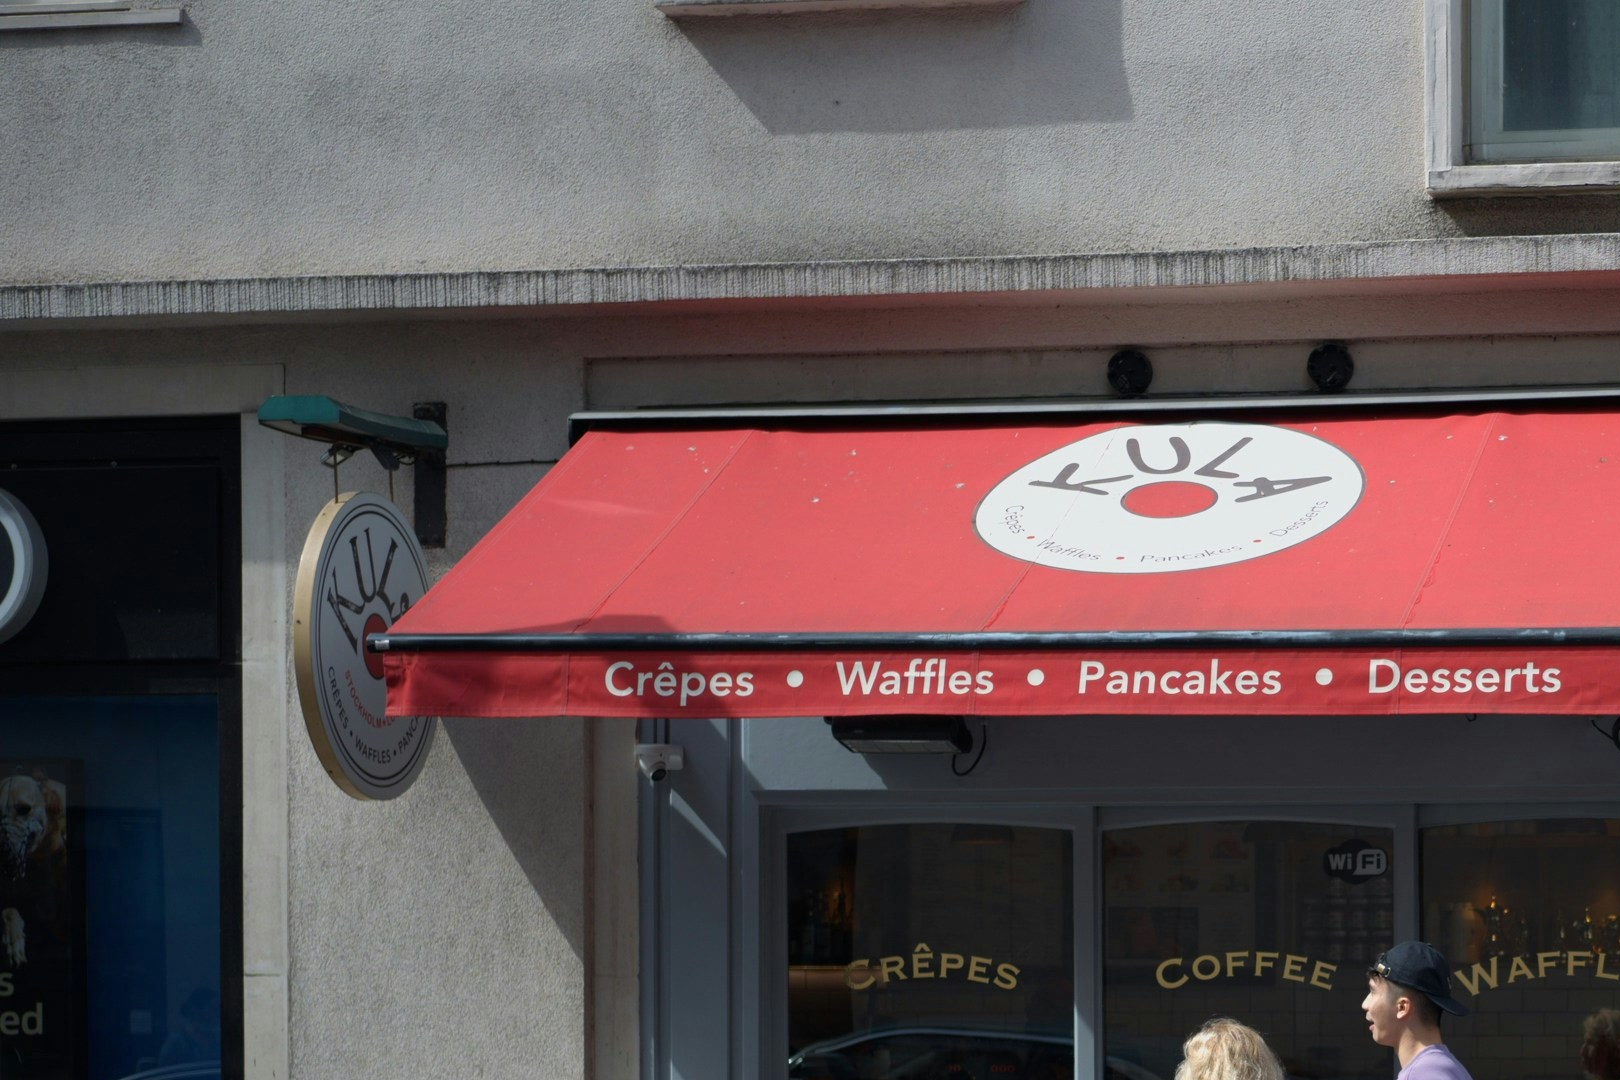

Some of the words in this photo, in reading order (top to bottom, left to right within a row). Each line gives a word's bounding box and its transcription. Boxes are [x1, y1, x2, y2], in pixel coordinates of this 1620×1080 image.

[1028, 436, 1333, 504] KULA
[1000, 504, 1026, 536] Crêpes
[1036, 537, 1102, 563] Waffles
[1140, 545, 1243, 564] Pancakes
[1268, 499, 1330, 538] Desserts
[604, 660, 755, 707] Crêpes
[836, 657, 995, 696] Waffles
[1077, 658, 1283, 696] Pancakes
[1367, 658, 1562, 695] Desserts
[327, 665, 350, 730] CRÊPES
[354, 734, 392, 765] WAFFLES
[843, 942, 1021, 991] CRÊPES
[1155, 950, 1338, 991] COFFEE
